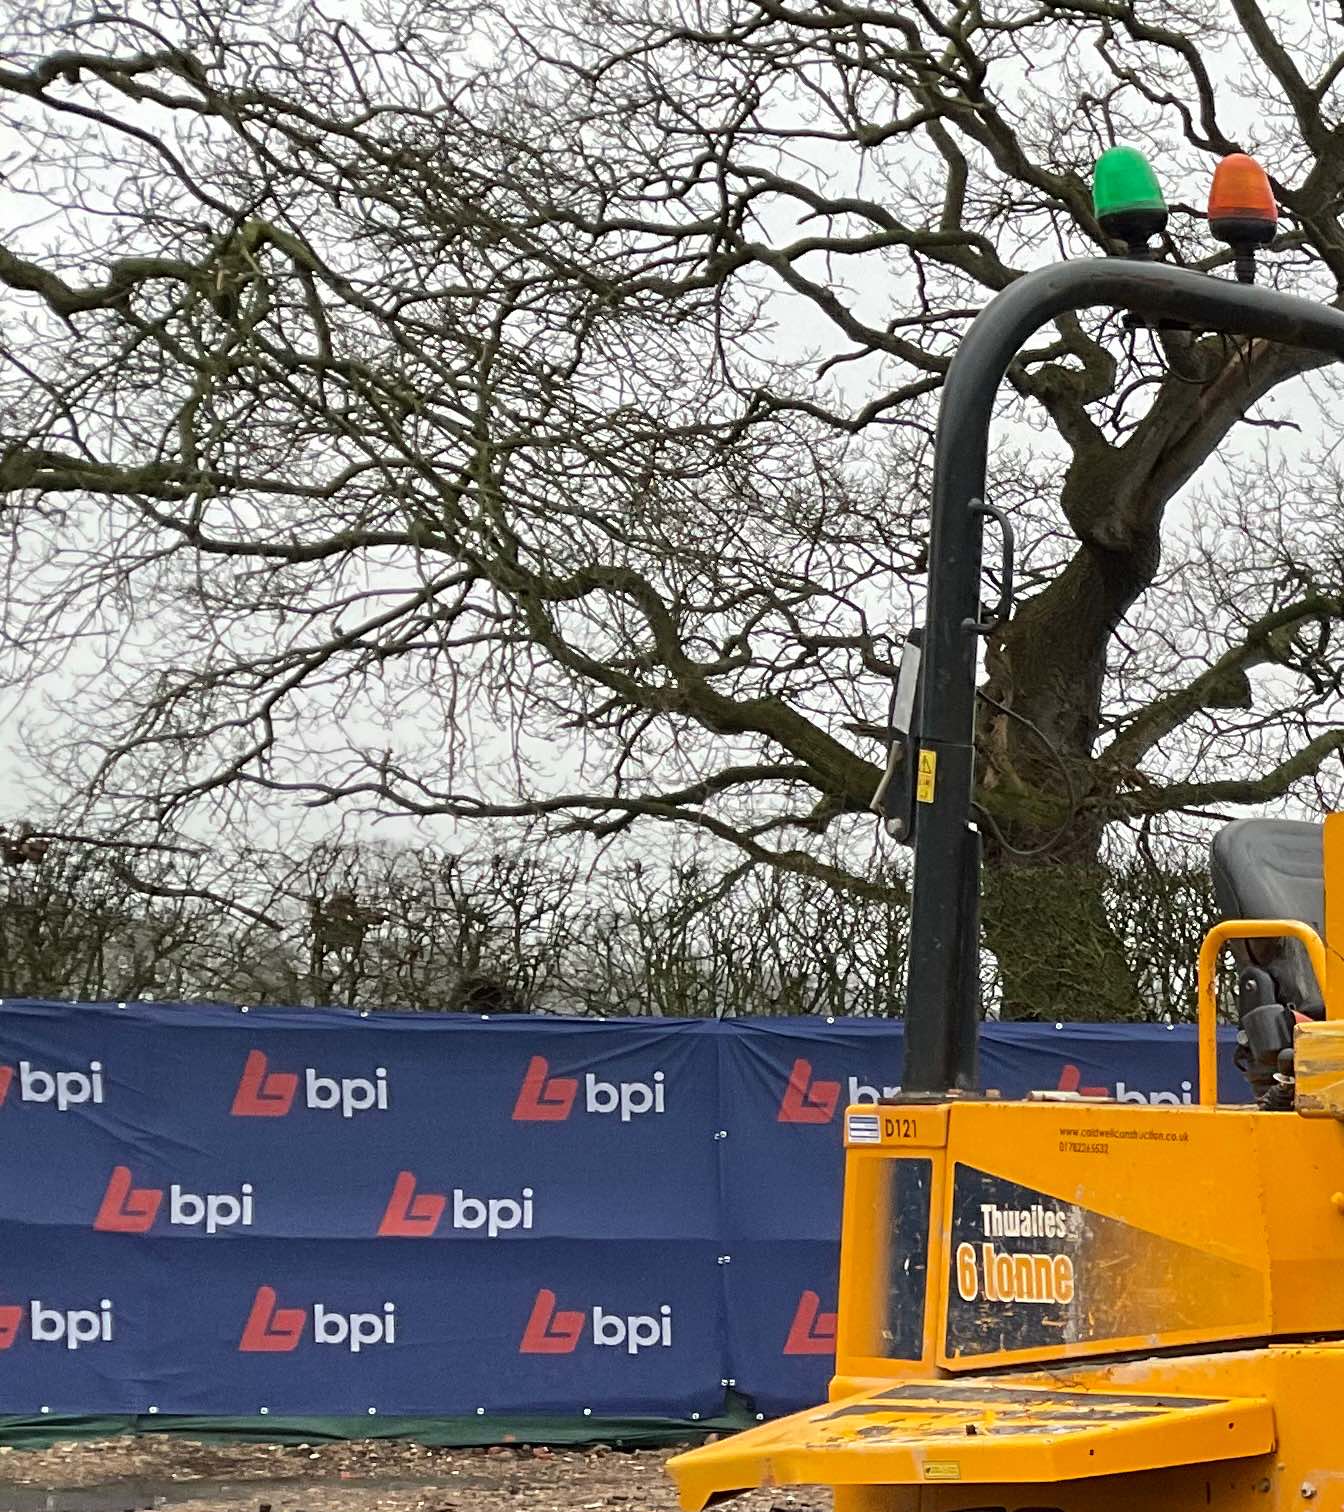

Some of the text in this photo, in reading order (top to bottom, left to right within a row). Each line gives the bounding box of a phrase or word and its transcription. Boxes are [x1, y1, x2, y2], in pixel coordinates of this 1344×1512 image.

[20, 1061, 102, 1110] bpi
[306, 1067, 387, 1117] bpi
[586, 1071, 664, 1121] bpi
[885, 1118, 917, 1138] D121
[171, 1184, 252, 1233] bpi
[454, 1187, 533, 1237] bpi
[981, 1204, 1066, 1238] Thwaites
[957, 1242, 1075, 1304] 6 tonne
[31, 1300, 111, 1349] bpi
[315, 1302, 394, 1352] bpi
[594, 1305, 671, 1354] bpi
